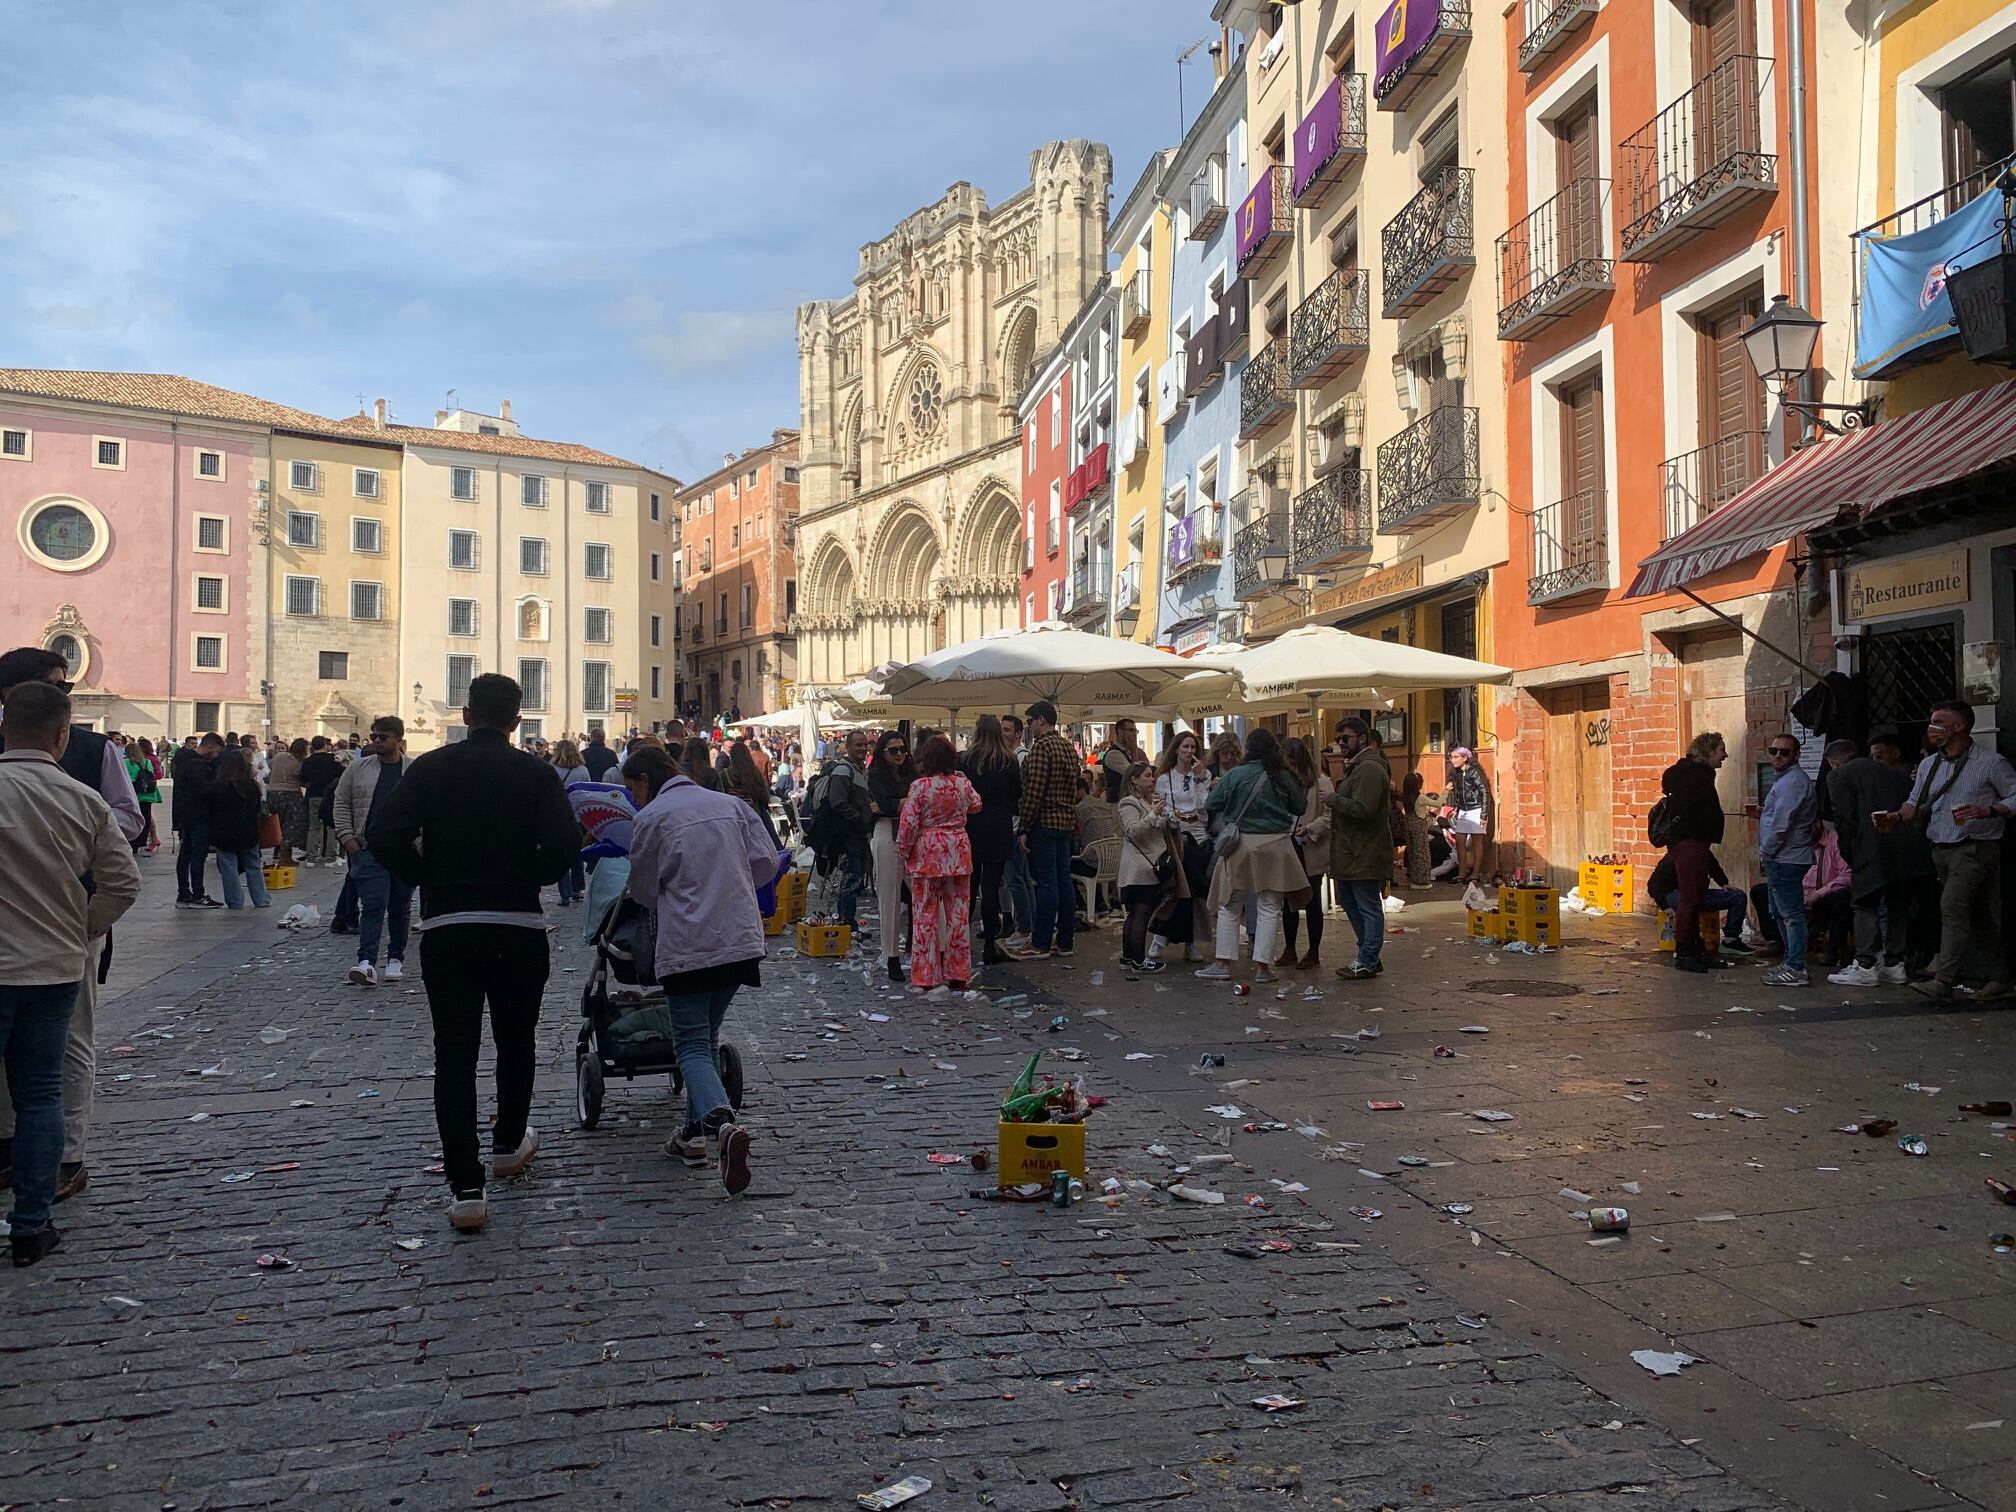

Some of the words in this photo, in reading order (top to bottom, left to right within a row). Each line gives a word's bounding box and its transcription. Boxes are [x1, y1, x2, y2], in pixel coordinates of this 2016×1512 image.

[1961, 286, 2002, 335] BAR
[1865, 575, 1961, 605] Restaurante
[1262, 682, 1295, 694] AMBAR
[1196, 704, 1224, 715] AMBAR
[1020, 1159, 1062, 1170] AMBAR
